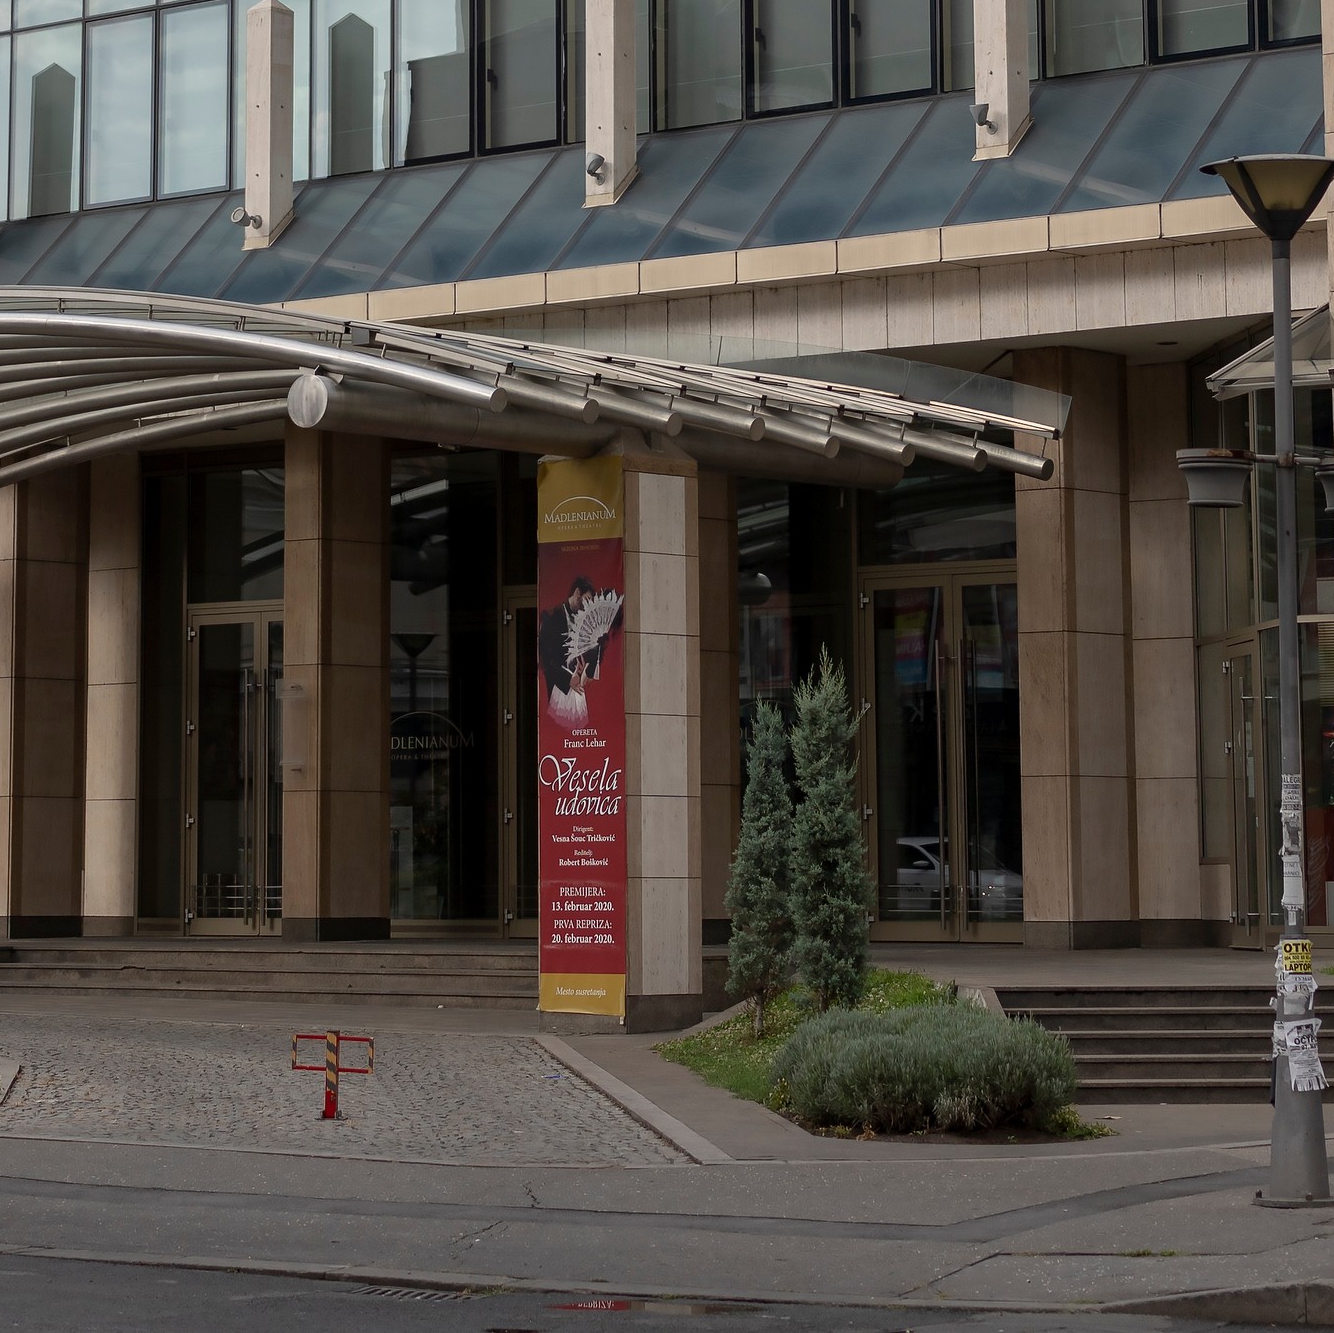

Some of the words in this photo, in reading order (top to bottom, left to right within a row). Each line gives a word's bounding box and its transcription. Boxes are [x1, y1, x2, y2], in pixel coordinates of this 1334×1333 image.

[544, 508, 617, 524] MADLENIANUM
[564, 739, 585, 748] Franc
[586, 737, 607, 748] Lehar
[539, 754, 622, 794] Vesela
[555, 789, 622, 816] udovica
[573, 825, 594, 834] Dirigent:
[552, 834, 570, 843] Vesna
[570, 833, 586, 843] Šouc
[586, 833, 616, 843] Tričković
[559, 858, 581, 866] Robert
[581, 857, 609, 866] Bošković
[559, 886, 606, 898] PREMIJERA:
[551, 901, 563, 911] 13.
[564, 901, 593, 911] februar
[593, 901, 614, 911] 2020.
[554, 919, 576, 929] PRVA
[576, 919, 613, 929] REPRIZA:
[551, 934, 563, 944] 20.
[564, 933, 593, 944] februar
[594, 934, 615, 944] 2020.
[555, 986, 575, 996] Mesto
[575, 987, 607, 998] susretanja
